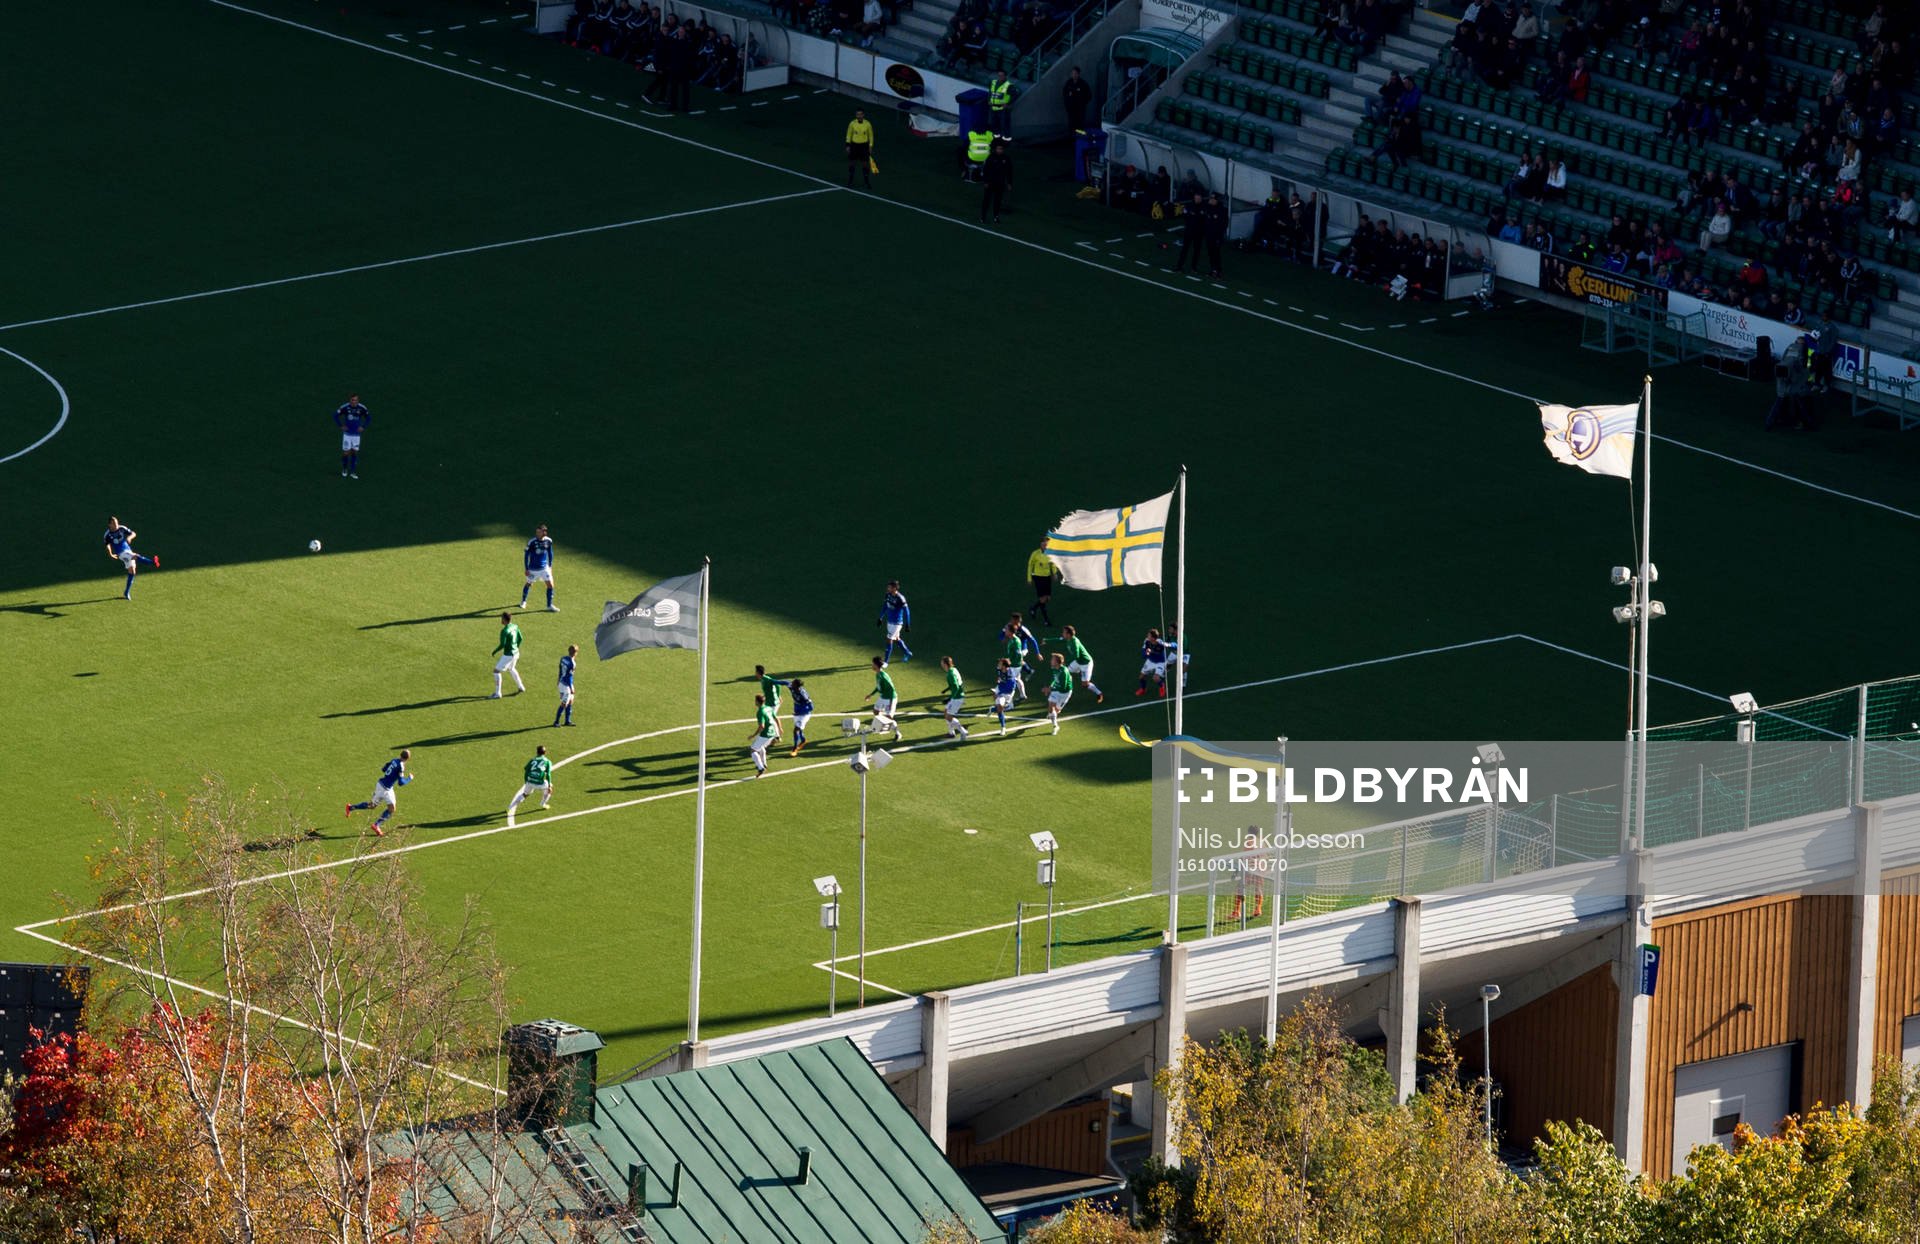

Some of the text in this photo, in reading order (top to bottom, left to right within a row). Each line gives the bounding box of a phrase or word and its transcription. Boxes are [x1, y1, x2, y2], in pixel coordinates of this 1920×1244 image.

[1738, 315, 1748, 332] &
[1721, 323, 1757, 344] Karströ
[530, 760, 546, 772] 24
[1644, 950, 1656, 968] P
